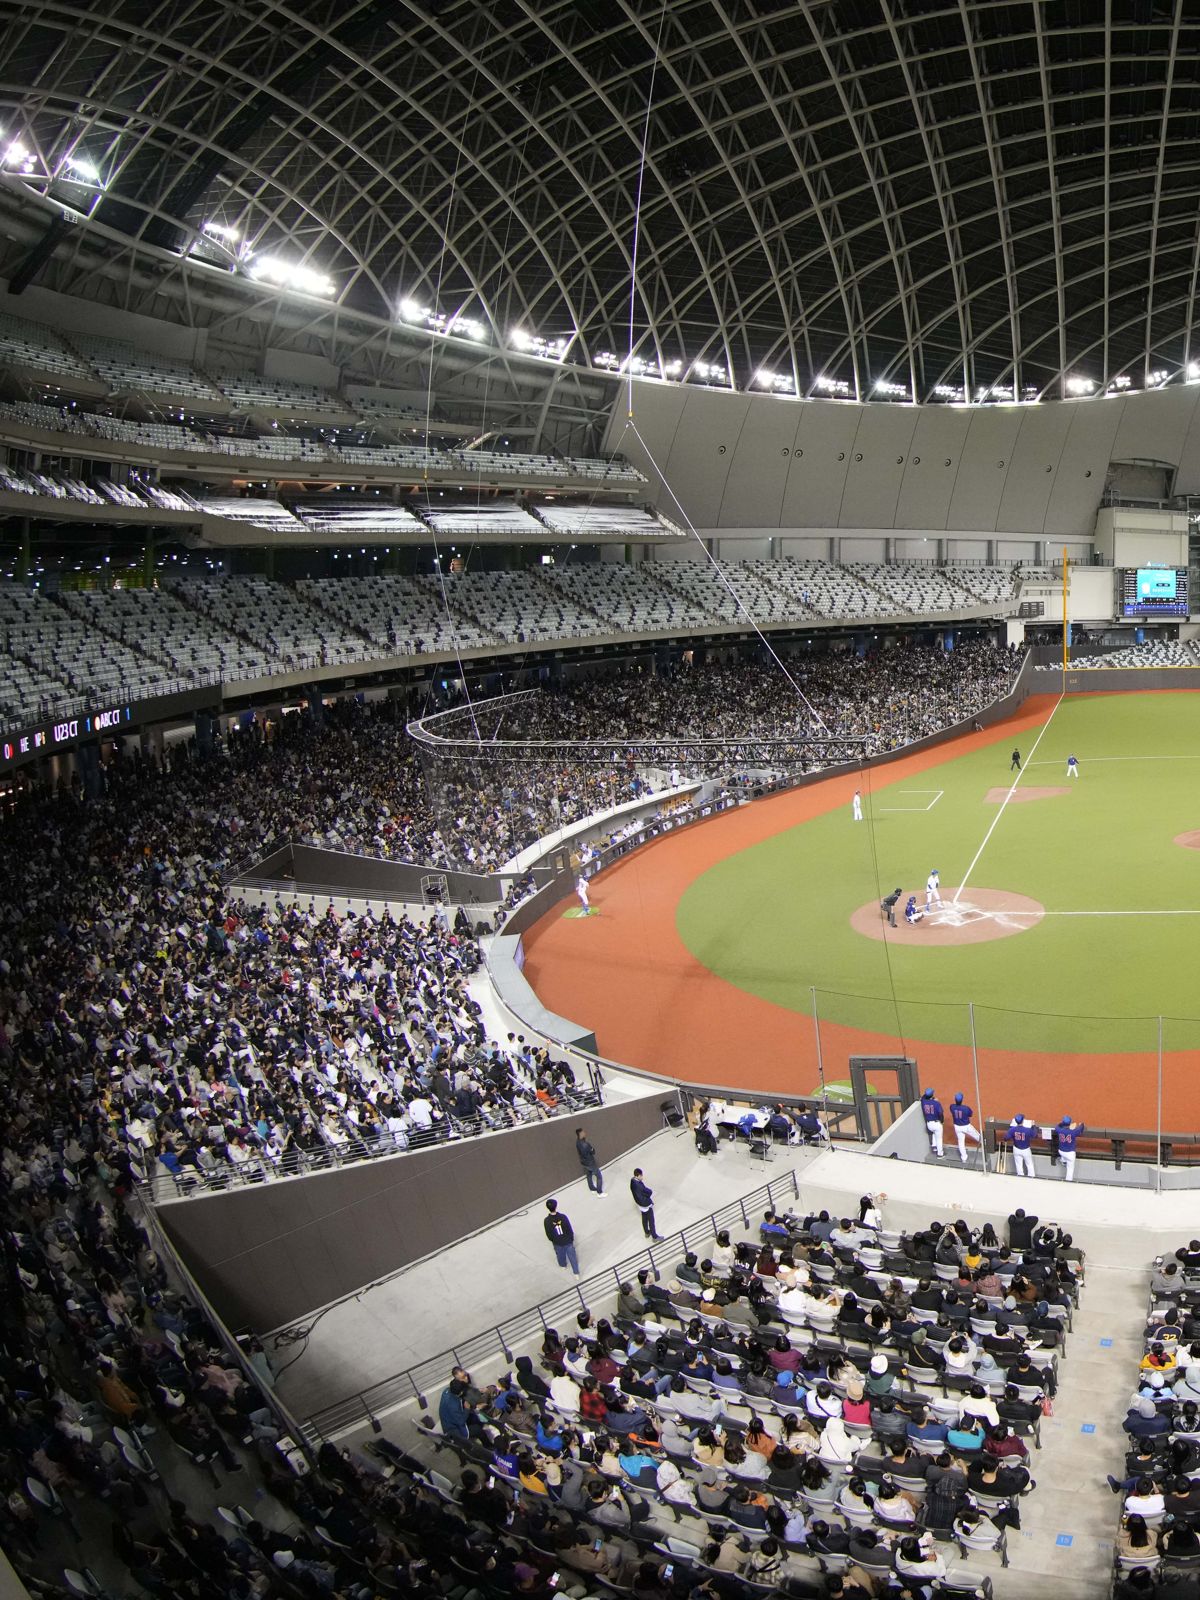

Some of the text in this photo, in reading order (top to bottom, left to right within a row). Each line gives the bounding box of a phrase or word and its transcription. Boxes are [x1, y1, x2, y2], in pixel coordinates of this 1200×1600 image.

[100, 707, 130, 728] ABC CT 1
[54, 718, 91, 742] U23 CT 1
[555, 1225, 563, 1235] 11
